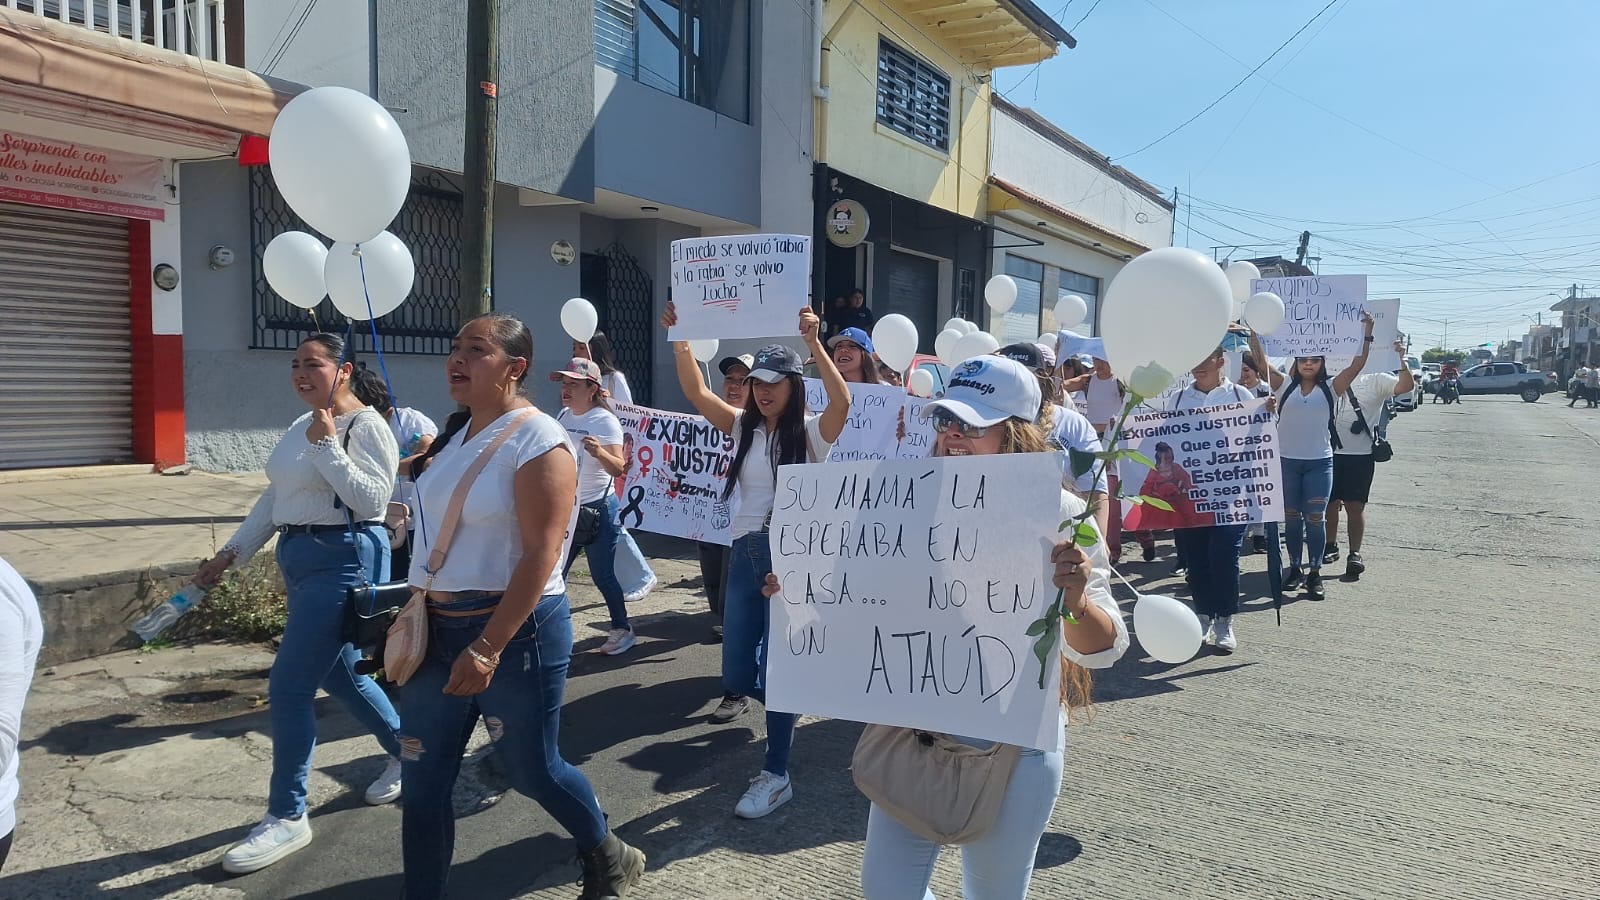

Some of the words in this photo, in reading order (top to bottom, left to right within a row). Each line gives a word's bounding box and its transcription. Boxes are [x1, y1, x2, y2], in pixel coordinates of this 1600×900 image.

[84, 151, 108, 165] con
[672, 242, 682, 262] El
[686, 241, 716, 261] miedo
[721, 243, 734, 257] se
[737, 238, 771, 256] volvió
[673, 271, 679, 285] y
[683, 267, 694, 283] la
[735, 264, 747, 278] se
[1306, 338, 1316, 346] un
[1319, 337, 1340, 345] caso
[615, 403, 651, 417] MARCHA
[864, 394, 888, 412] por
[1134, 409, 1185, 423] MARCHA
[1188, 402, 1244, 416] PACIFICA
[1194, 412, 1271, 432] JUSTICIA!!
[906, 432, 928, 447] SIN
[1181, 440, 1211, 453] Que
[1215, 436, 1230, 448] el
[1234, 433, 1272, 446] caso
[1182, 457, 1201, 469] de
[1206, 446, 1274, 466] Jazmín
[1191, 463, 1269, 484] Estefani
[780, 476, 818, 511] SU
[834, 470, 935, 510] MAMÁ
[951, 473, 986, 510] LA
[1190, 488, 1209, 499] no
[1213, 485, 1241, 497] sea
[1245, 481, 1274, 493] uno
[1196, 499, 1229, 512] más
[1233, 497, 1253, 508] en
[1258, 495, 1271, 506] la
[1217, 511, 1255, 524] lista.
[779, 520, 906, 558] ESPERABA
[927, 522, 979, 563] EN
[782, 570, 887, 606] CASA...
[928, 576, 968, 611] NO
[986, 577, 1036, 614] EN
[788, 624, 827, 656] UN
[865, 624, 1016, 704] ATAÚD
